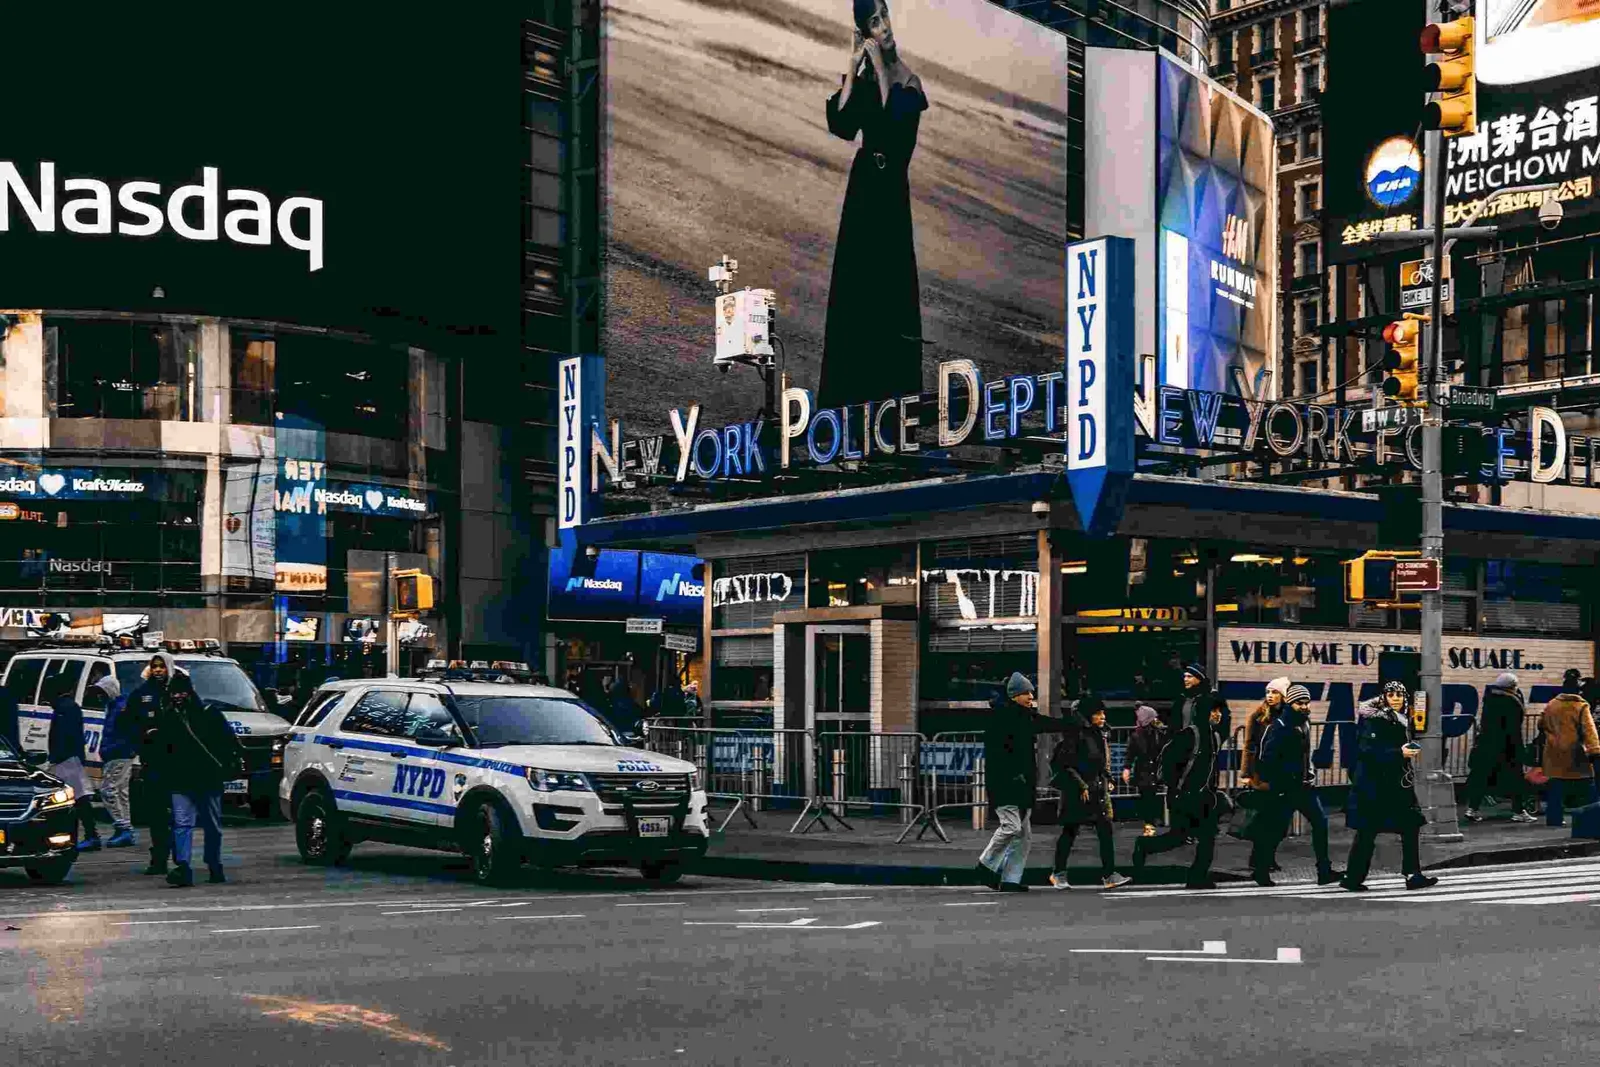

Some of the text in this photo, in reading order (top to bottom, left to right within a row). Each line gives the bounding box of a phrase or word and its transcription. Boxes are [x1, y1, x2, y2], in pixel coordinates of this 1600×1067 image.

[0, 161, 324, 272] Nasdaq
[1210, 259, 1257, 297] RUNWAY
[1403, 290, 1422, 304] BIKE
[1077, 249, 1098, 461] NYPD
[1134, 355, 1222, 446] NEW
[1233, 369, 1358, 462] YORK
[1452, 389, 1495, 410] Broadway
[590, 359, 1064, 493] NEW YORK POLICE DEPT
[1377, 410, 1388, 427] W
[1394, 408, 1408, 424] 43
[564, 364, 576, 522] NYPD
[315, 488, 363, 508] Nasdaq
[50, 559, 112, 576] Nasdaq
[584, 578, 623, 592] Nasdaq
[1230, 640, 1343, 666] WELCOME
[1351, 643, 1375, 667] TO
[393, 764, 446, 799] NYPD
